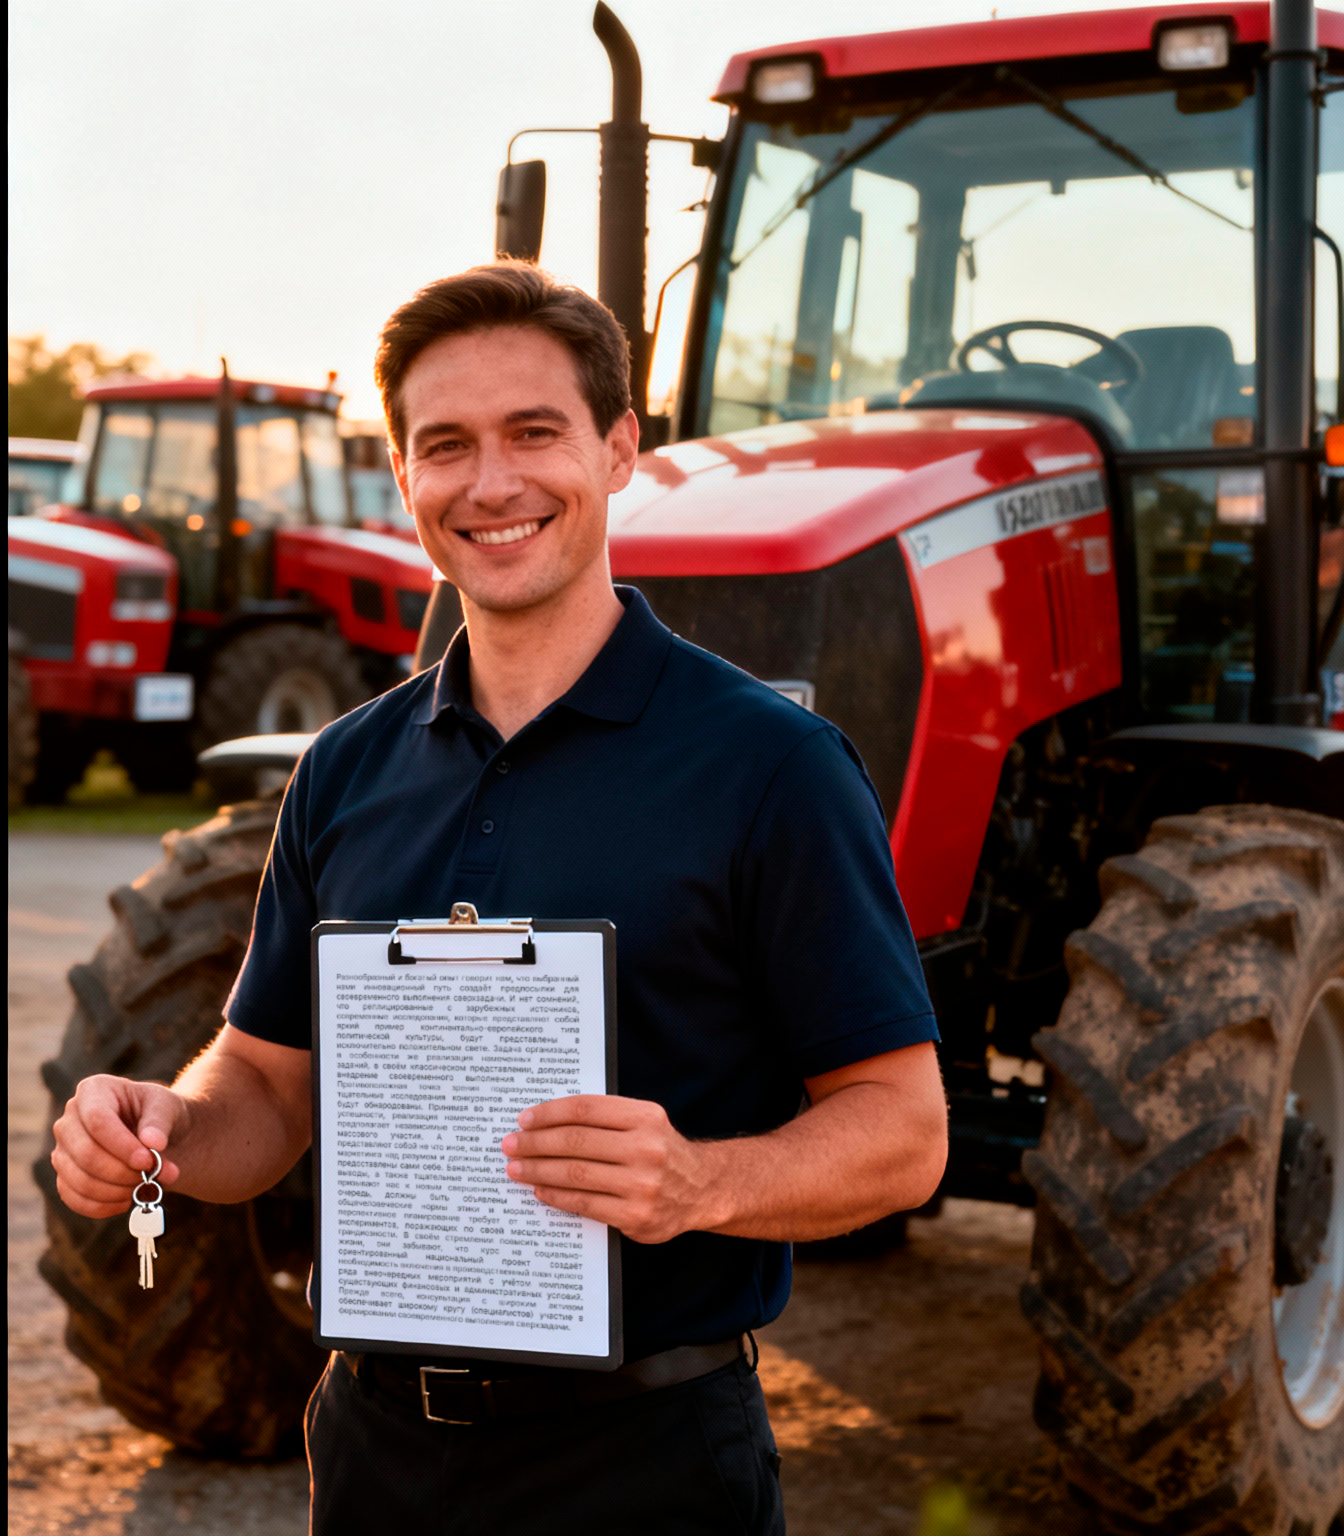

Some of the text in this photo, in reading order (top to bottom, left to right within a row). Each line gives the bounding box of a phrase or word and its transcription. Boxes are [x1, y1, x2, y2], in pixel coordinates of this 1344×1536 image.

[459, 984, 491, 992] создаёт
[336, 993, 400, 1001] своевременного
[536, 995, 579, 1003] сомнений,
[466, 1004, 515, 1013] зарубежных
[336, 1022, 359, 1030] яркий
[374, 1024, 404, 1032] пример
[405, 1034, 444, 1042] культуры,
[459, 1034, 482, 1043] будут
[493, 1045, 522, 1053] Задача
[336, 1061, 369, 1069] заданий,
[469, 1065, 533, 1074] представлении,
[336, 1072, 378, 1080] внедрение
[388, 1073, 454, 1081] своевременного
[452, 1095, 502, 1103] конкурентов
[336, 1100, 468, 1112] будут обнародованы. Принимая
[337, 1111, 385, 1119] успешности,
[392, 1113, 438, 1121] реализация
[337, 1150, 382, 1158] маркетинга
[401, 1153, 437, 1161] разумом
[337, 1160, 397, 1168] предоставлены
[446, 1163, 492, 1174] Банальные,
[337, 1170, 369, 1178] выводы,
[447, 1185, 500, 1194] свершениям,
[337, 1189, 372, 1198] очередь,
[462, 1194, 507, 1203] объявлены
[420, 1203, 448, 1211] нормы
[502, 1207, 536, 1215] морали.
[337, 1209, 396, 1218] перспективное
[403, 1212, 460, 1221] планирование
[468, 1215, 500, 1224] требует
[338, 1219, 398, 1229] экспериментов,
[404, 1222, 457, 1231] поражающих
[510, 1228, 570, 1238] масштабности
[338, 1229, 397, 1238] грандиозности.
[444, 1235, 494, 1243] стремлении
[338, 1239, 364, 1247] жизни,
[402, 1241, 442, 1251] забывают,
[480, 1247, 499, 1255] курс
[425, 1254, 484, 1263] национальный
[364, 1270, 420, 1279] внеочередных
[427, 1274, 481, 1283] мероприятий
[501, 1278, 531, 1286] учётом
[538, 1281, 583, 1290] комплекса
[338, 1278, 397, 1288] существующих
[401, 1281, 450, 1291] финансовых
[546, 1292, 583, 1301] условий.
[338, 1287, 583, 1311] Прежде всего, консультация широким активом
[338, 1297, 392, 1307] обеспечивает
[397, 1302, 438, 1312] широкому
[443, 1305, 465, 1314] кругу
[539, 1312, 573, 1320] участие
[338, 1306, 570, 1331] формировании своевременного выполнения сверхзадачи.
